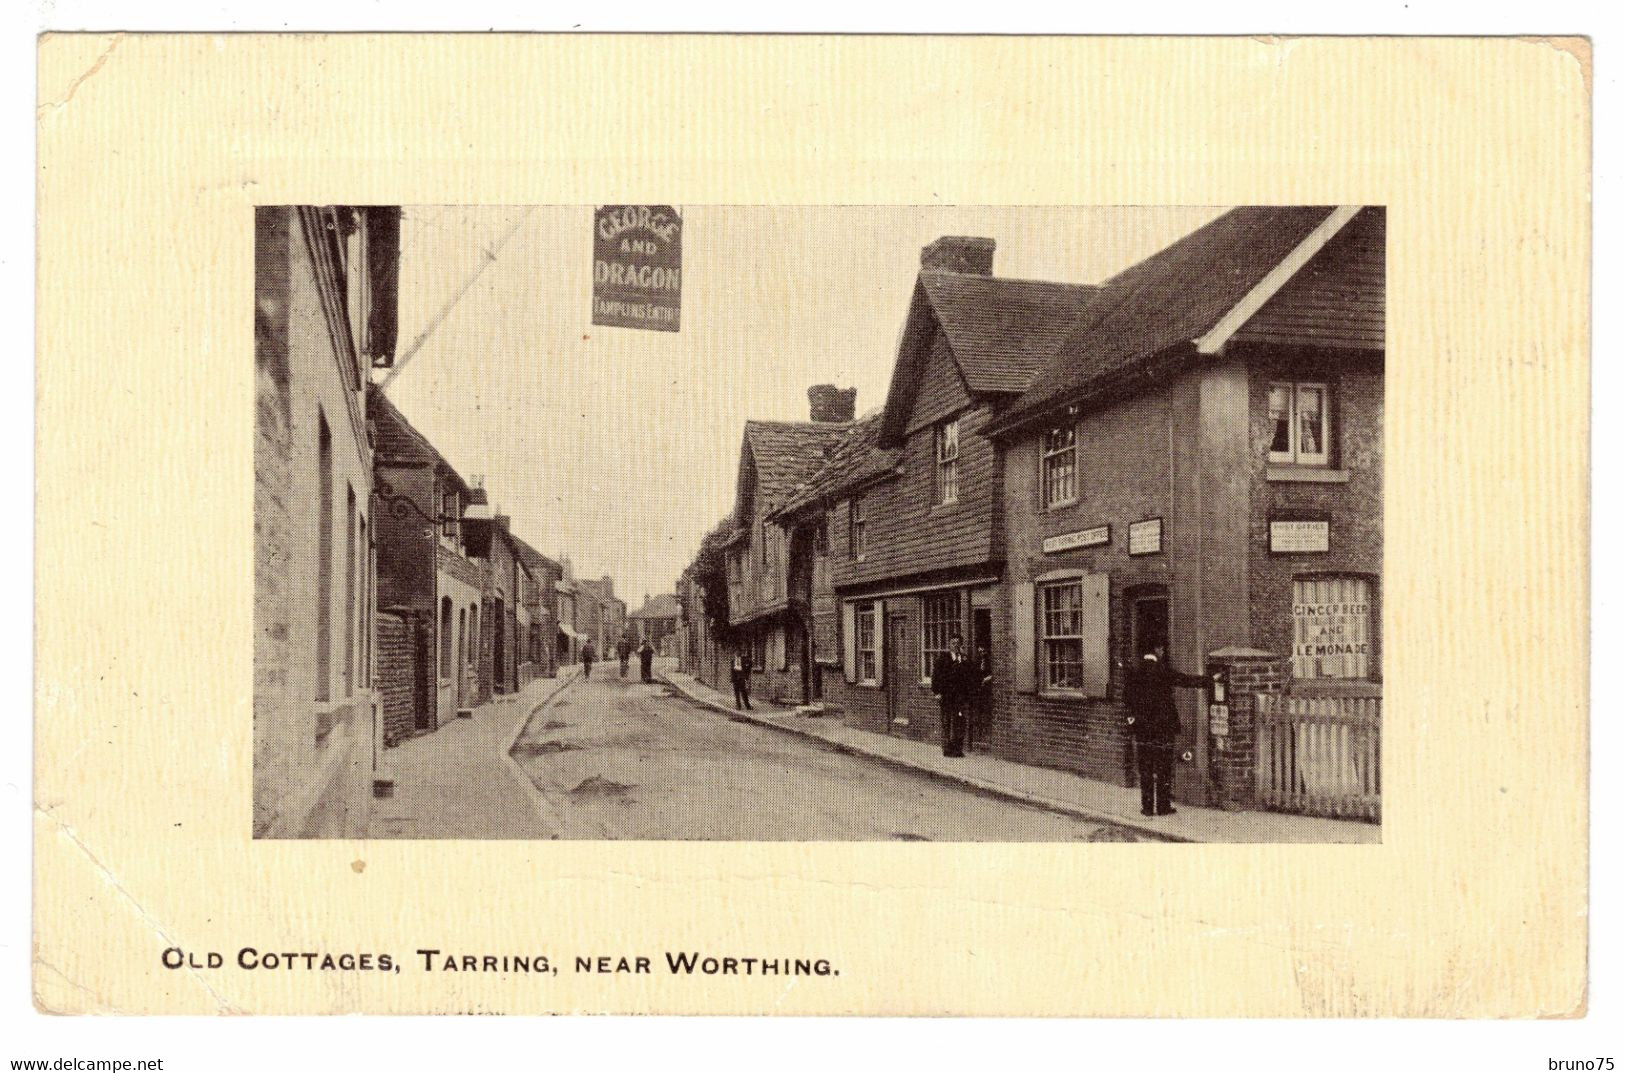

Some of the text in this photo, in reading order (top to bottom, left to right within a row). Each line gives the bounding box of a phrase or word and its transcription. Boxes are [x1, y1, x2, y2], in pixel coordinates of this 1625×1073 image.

[599, 206, 680, 241] GEORGE
[620, 238, 657, 255] AND
[595, 259, 680, 291] DRAGON
[1342, 604, 1368, 615] BEER
[1320, 625, 1344, 635] AND
[1297, 643, 1368, 656] LEMONADE
